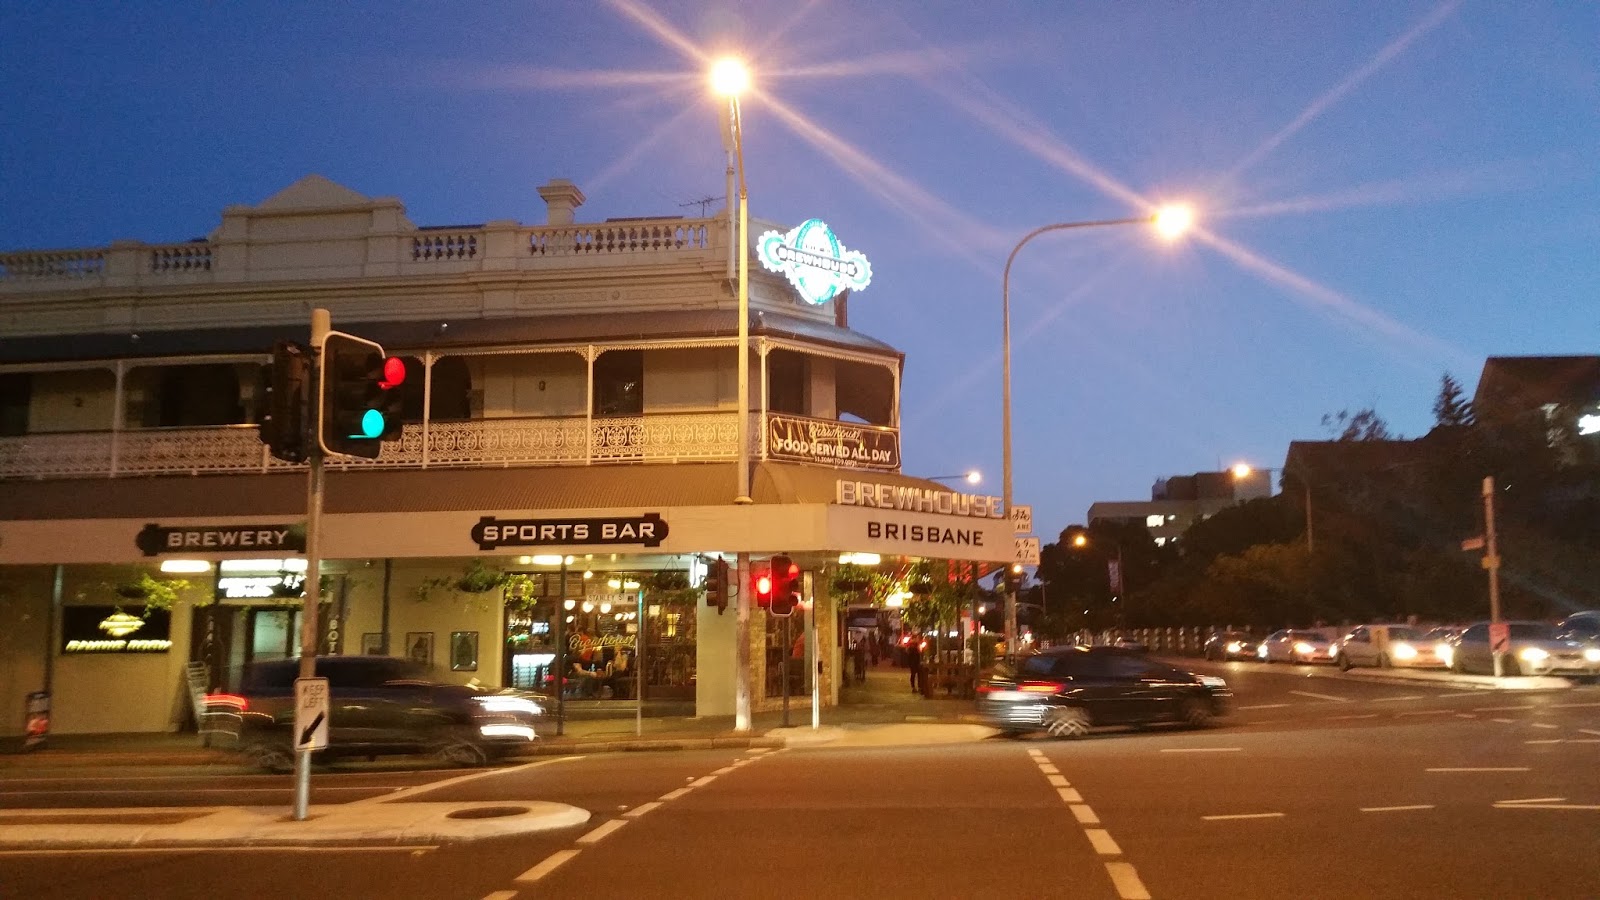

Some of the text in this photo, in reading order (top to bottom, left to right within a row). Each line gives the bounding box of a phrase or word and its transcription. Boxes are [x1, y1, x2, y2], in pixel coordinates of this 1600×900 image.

[778, 438, 891, 462] FOOD SERVED ALL DAY
[836, 479, 1004, 518] BREWHOUSE
[167, 530, 289, 547] BREWERY
[483, 522, 655, 541] SPORTS BAR
[867, 521, 984, 546] BRISBANE
[303, 684, 325, 696] KEEP
[304, 697, 324, 708] LEFT
